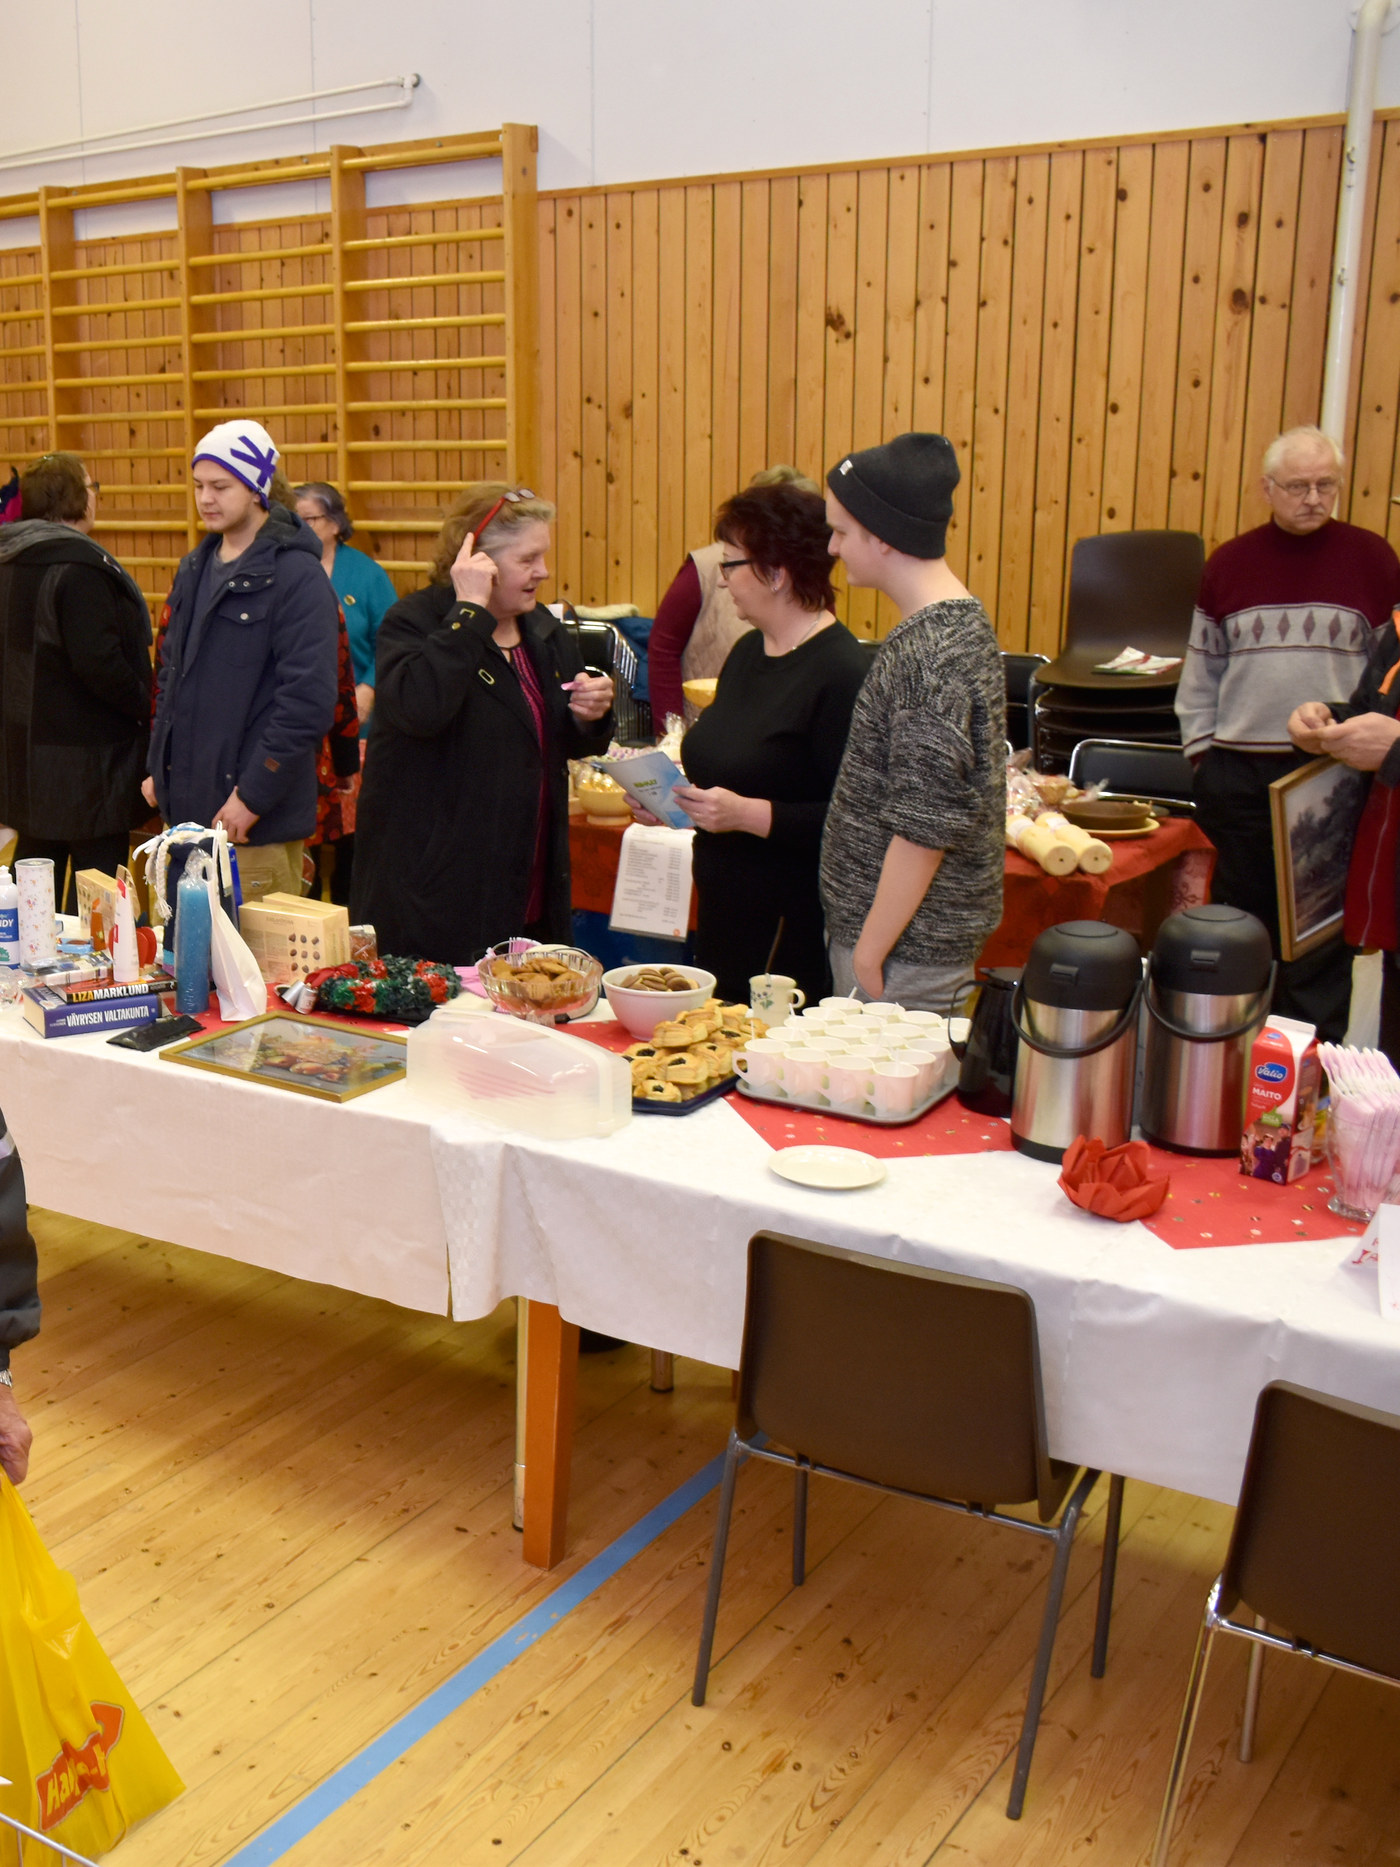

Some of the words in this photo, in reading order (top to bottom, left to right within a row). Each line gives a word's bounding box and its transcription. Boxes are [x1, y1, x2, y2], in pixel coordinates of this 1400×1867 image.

[66, 1012, 103, 1027] VÄYRYSEN
[104, 1006, 149, 1022] VALTAKUNTA
[1258, 1066, 1284, 1080] Valio
[1252, 1087, 1282, 1101] MAITO
